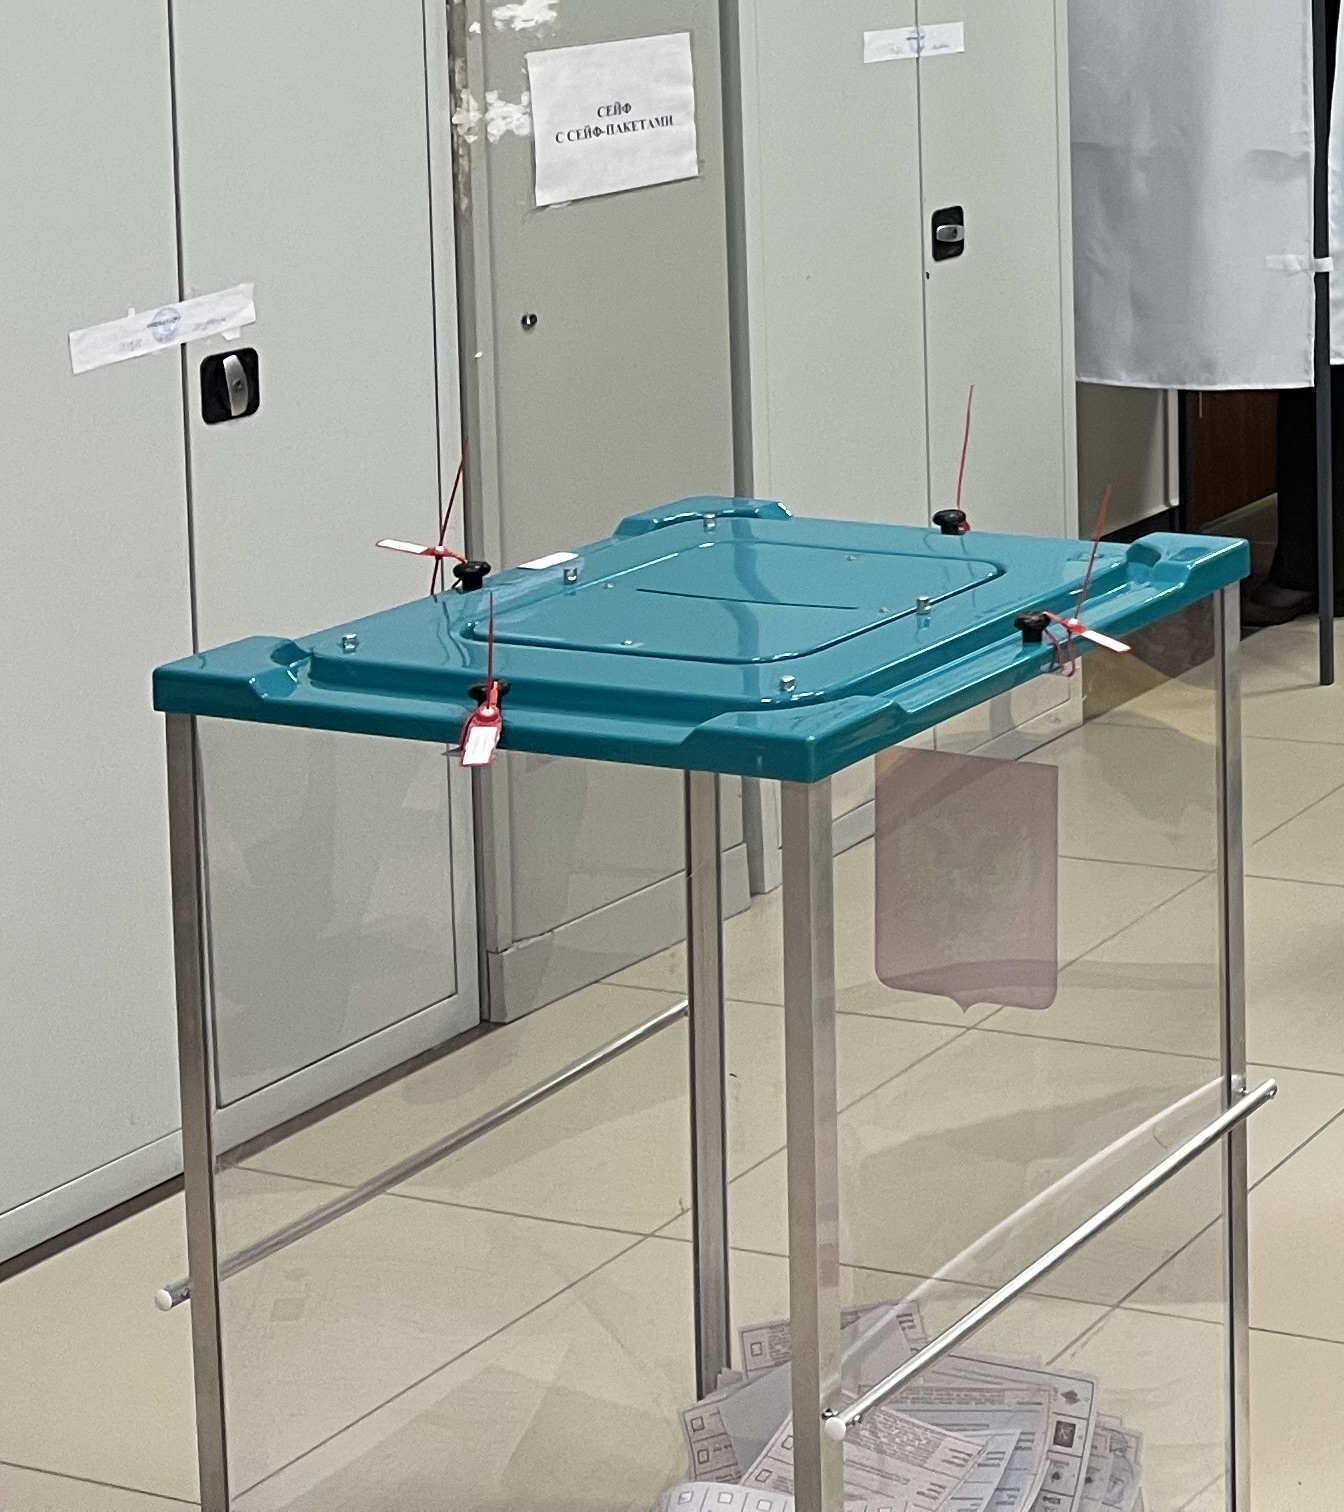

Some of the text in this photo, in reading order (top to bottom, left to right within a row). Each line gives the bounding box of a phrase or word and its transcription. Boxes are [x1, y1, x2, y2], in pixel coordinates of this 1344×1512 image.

[597, 101, 632, 118] СЕЙФ
[555, 115, 674, 144] С СЕЙФ-ПАКЕТАМИ
